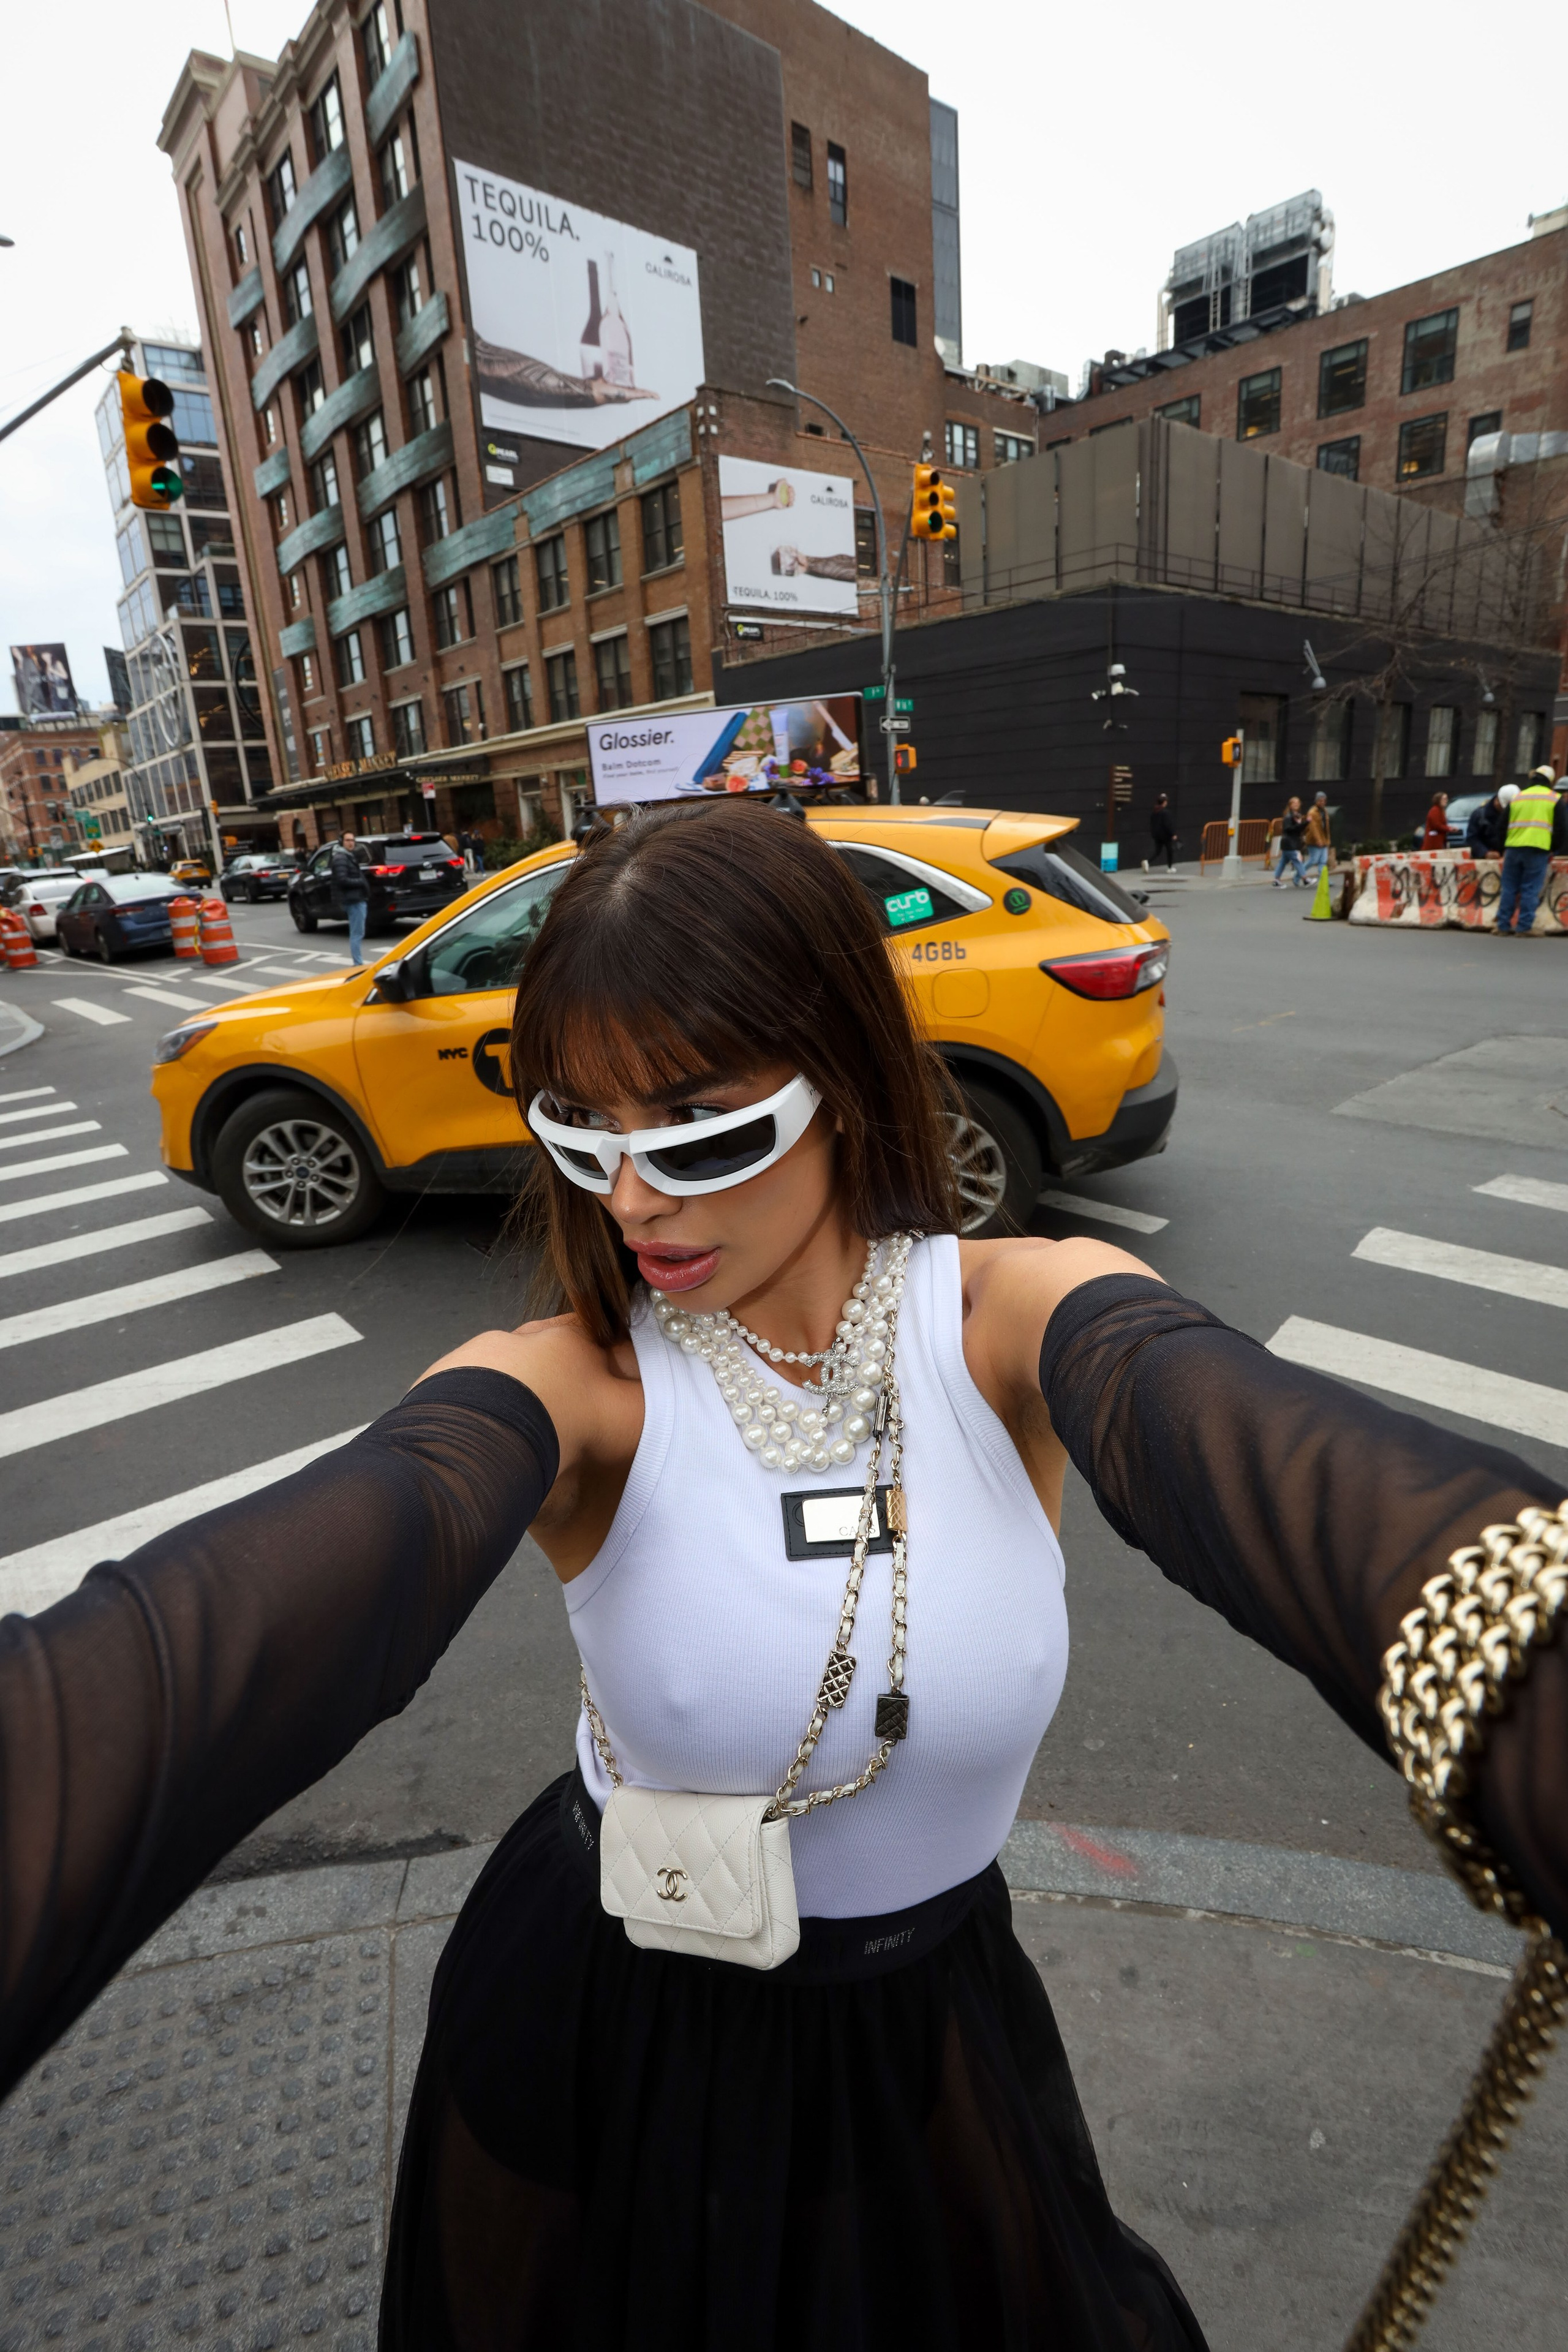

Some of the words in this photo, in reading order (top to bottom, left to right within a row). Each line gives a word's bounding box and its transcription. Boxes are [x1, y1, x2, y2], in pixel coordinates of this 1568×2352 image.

[464, 173, 580, 241] TEQUILA.
[472, 213, 549, 262] 100%
[774, 591, 798, 601] 100%
[599, 728, 674, 751] Glossier.
[886, 891, 929, 912] curb
[438, 1047, 468, 1060] NYC
[864, 1928, 915, 1954] INFINITY
